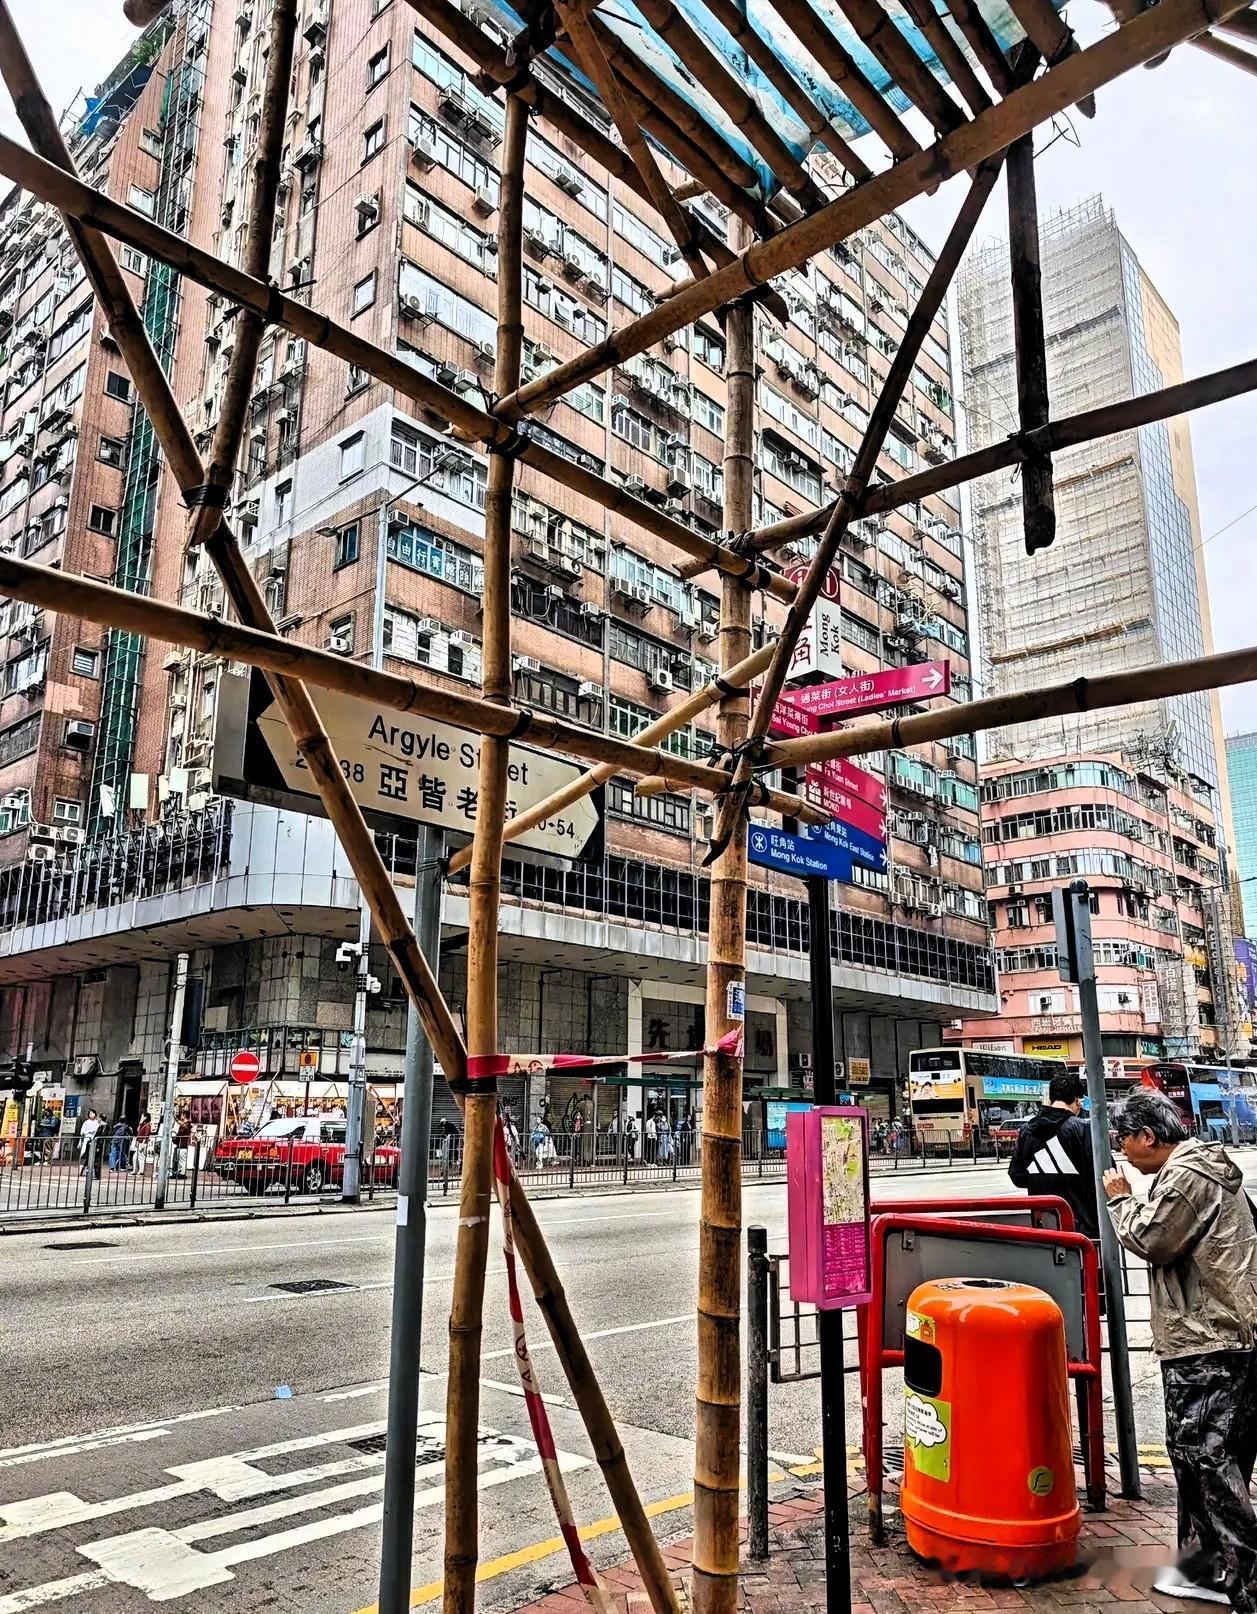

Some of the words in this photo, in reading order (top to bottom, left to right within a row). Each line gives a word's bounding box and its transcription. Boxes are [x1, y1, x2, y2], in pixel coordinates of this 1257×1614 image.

[820, 613, 831, 657] Mong
[831, 625, 840, 655] Kok
[835, 698, 857, 708] Street
[887, 686, 916, 698] Market)
[367, 713, 451, 761] Argyle
[532, 818, 576, 839] 0-54
[770, 834, 796, 851] 旺角站
[824, 831, 839, 846] Mong
[838, 838, 849, 849] Kok
[849, 842, 860, 855] East
[770, 847, 790, 863] Mong
[791, 853, 805, 865] Kok
[805, 857, 828, 871] Station
